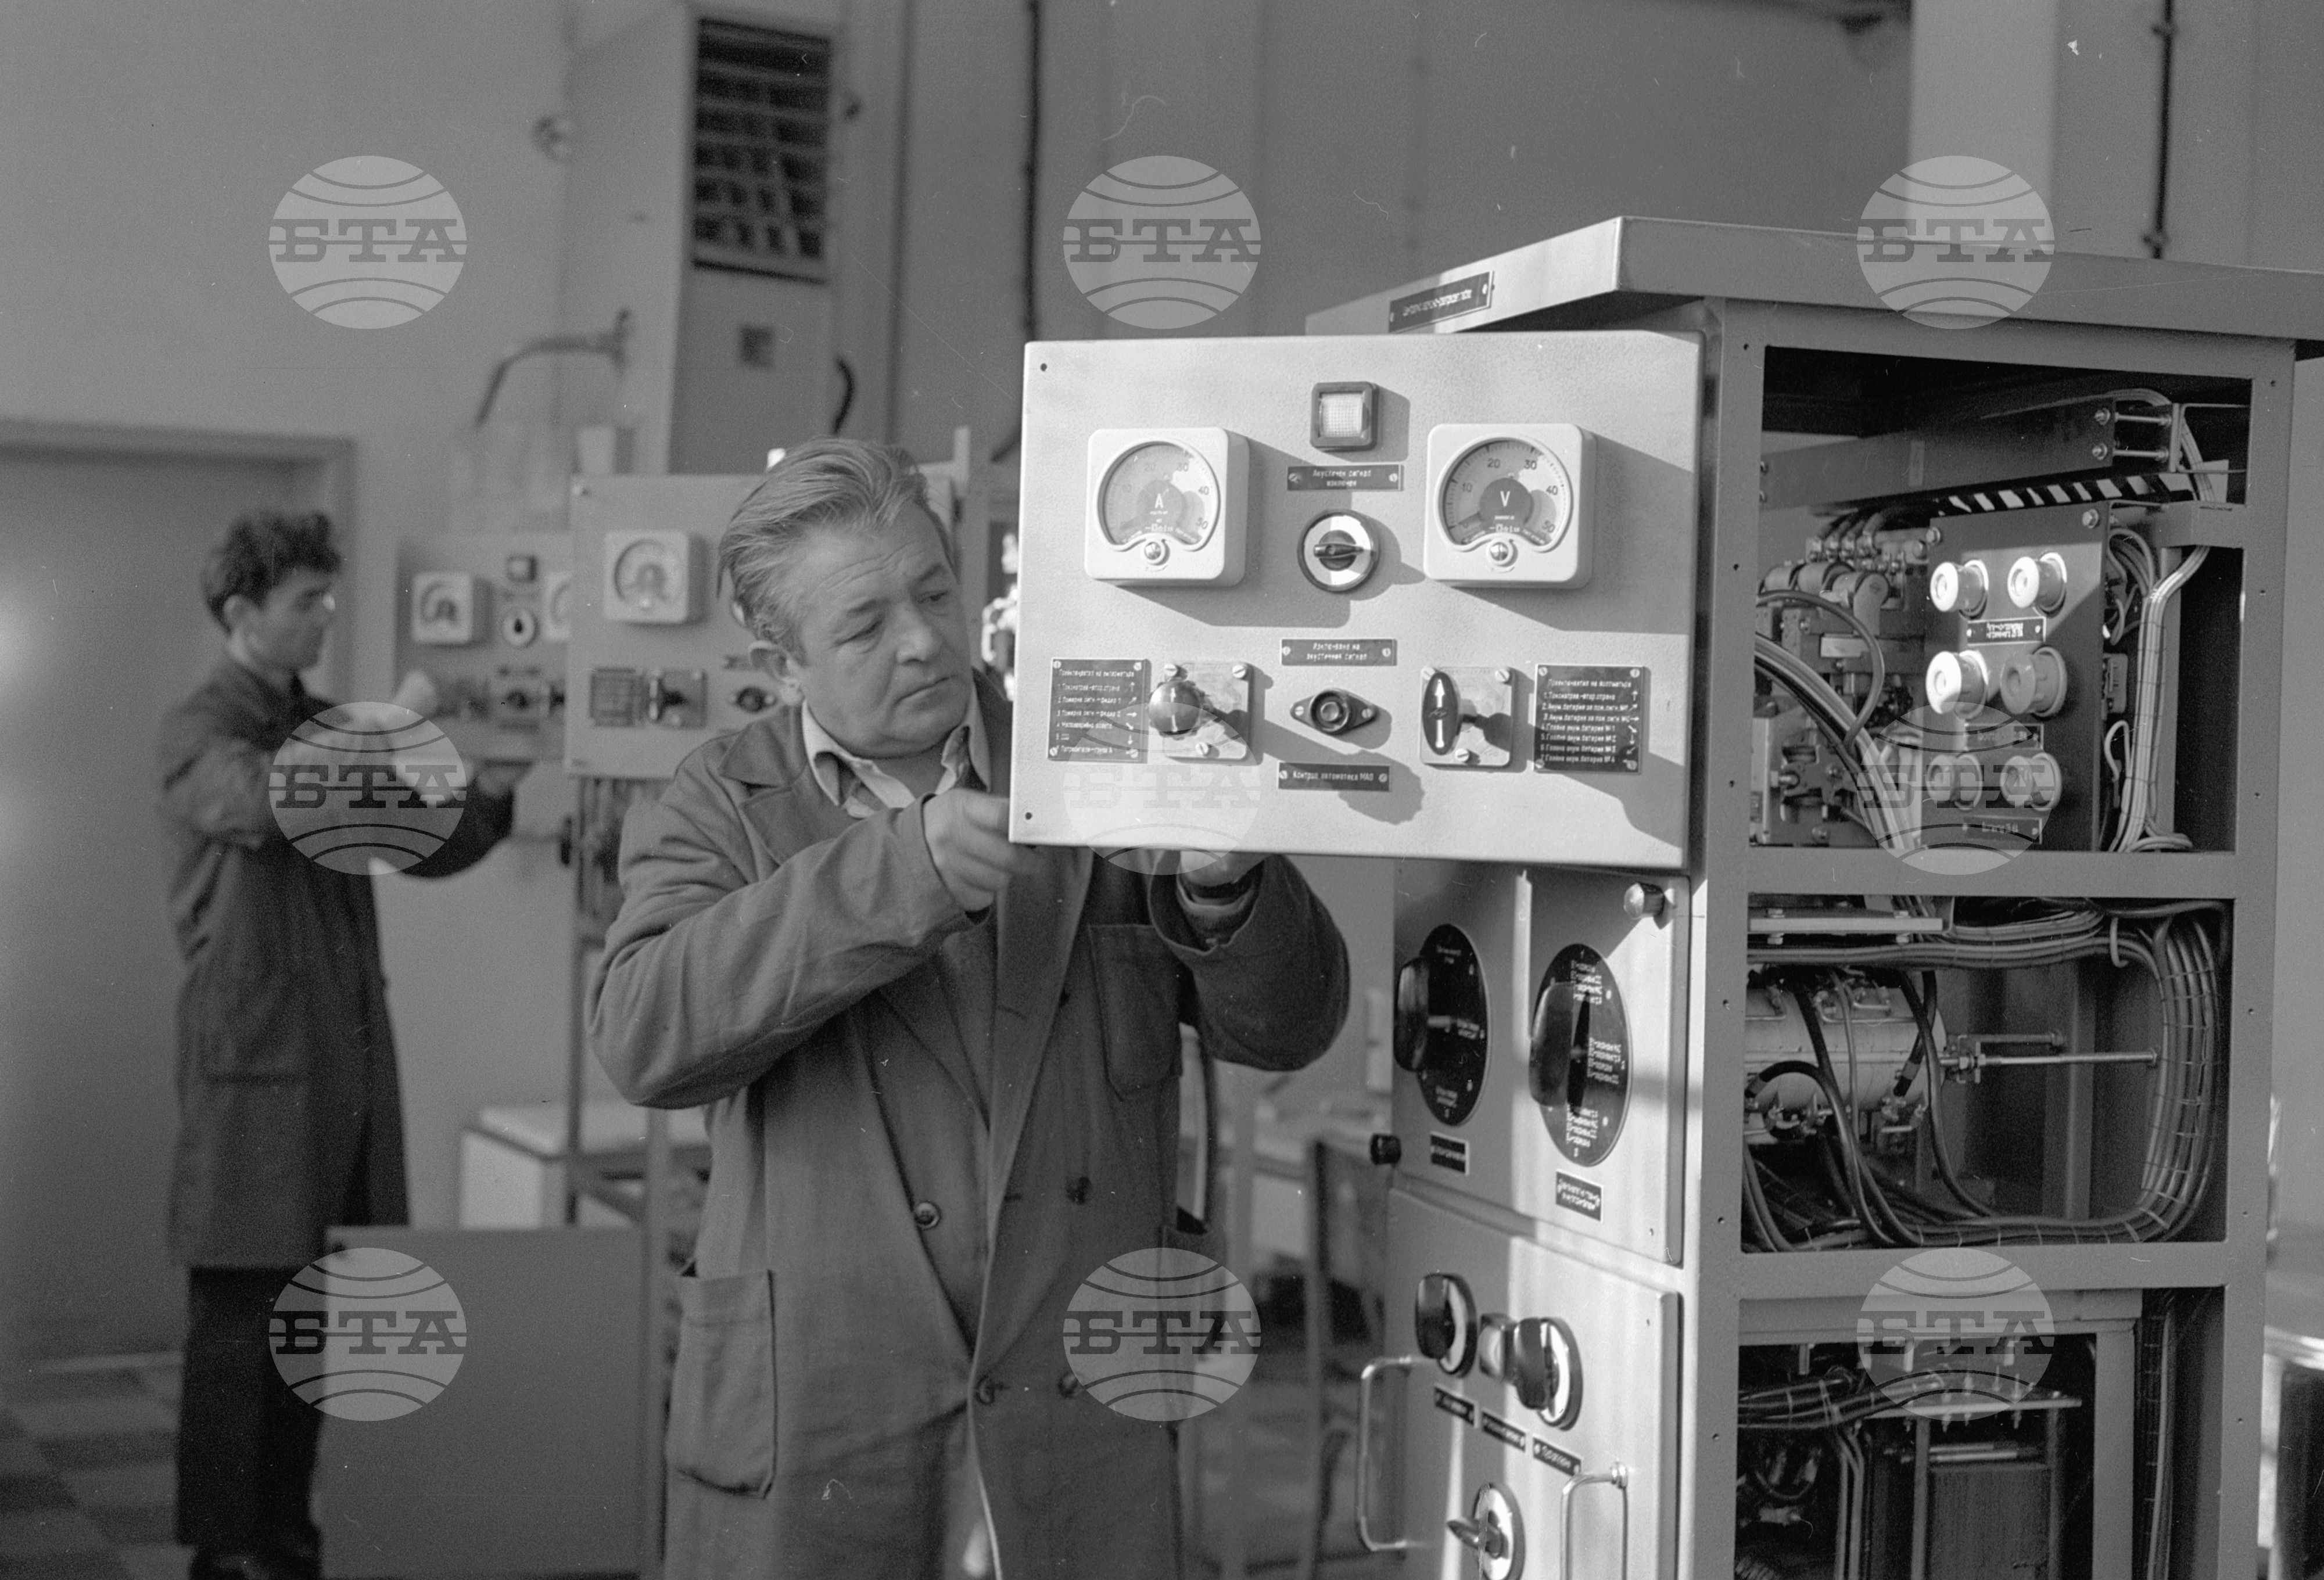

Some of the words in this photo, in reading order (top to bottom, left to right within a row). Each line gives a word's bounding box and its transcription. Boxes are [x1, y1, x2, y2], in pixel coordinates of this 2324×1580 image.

[1487, 458, 1501, 469] 20
[1524, 459, 1537, 470] 30
[1198, 486, 1209, 495] 40
[1462, 483, 1473, 493] 10
[1546, 486, 1558, 495] 40
[1154, 493, 1164, 508] A
[1500, 491, 1510, 507] V
[1196, 517, 1208, 530] 50
[1541, 520, 1555, 533] 50
